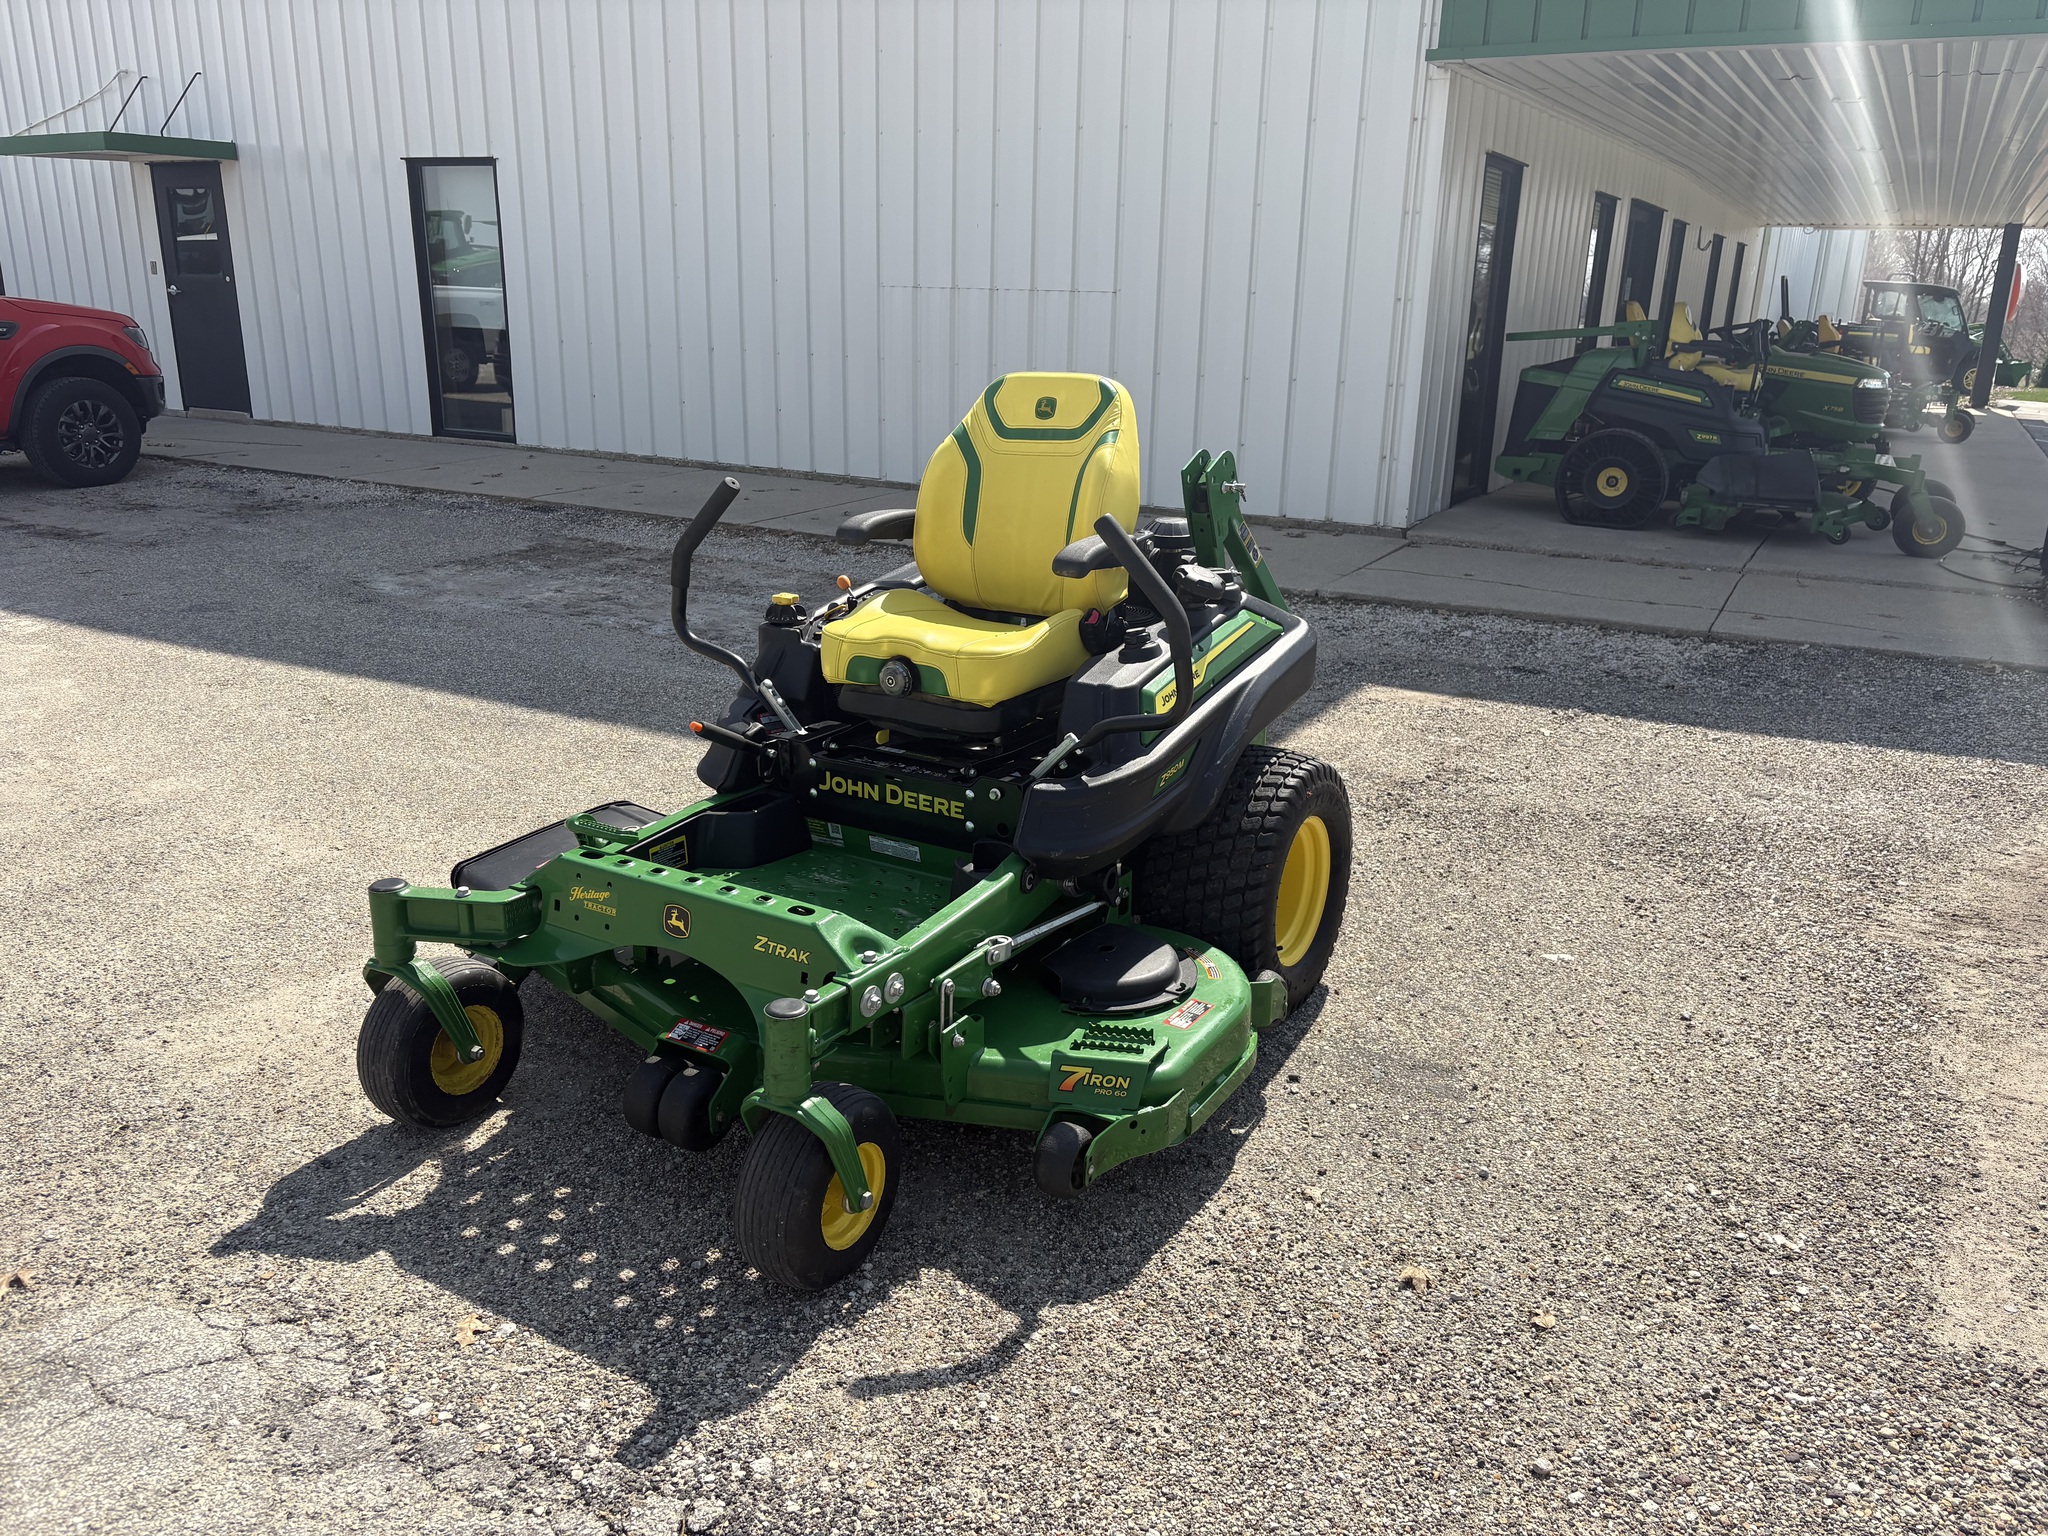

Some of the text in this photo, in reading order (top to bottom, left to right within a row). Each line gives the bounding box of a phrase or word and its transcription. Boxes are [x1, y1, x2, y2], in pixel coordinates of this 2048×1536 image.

[1777, 367, 1805, 378] DEERE
[1624, 382, 1660, 394] JOHN DEERE
[818, 771, 965, 820] JOHN DEERE
[569, 886, 611, 902] Heritage
[584, 901, 617, 915] TRACTOR
[753, 935, 811, 965] ZTRAK
[1094, 1088, 1113, 1096] PRO
